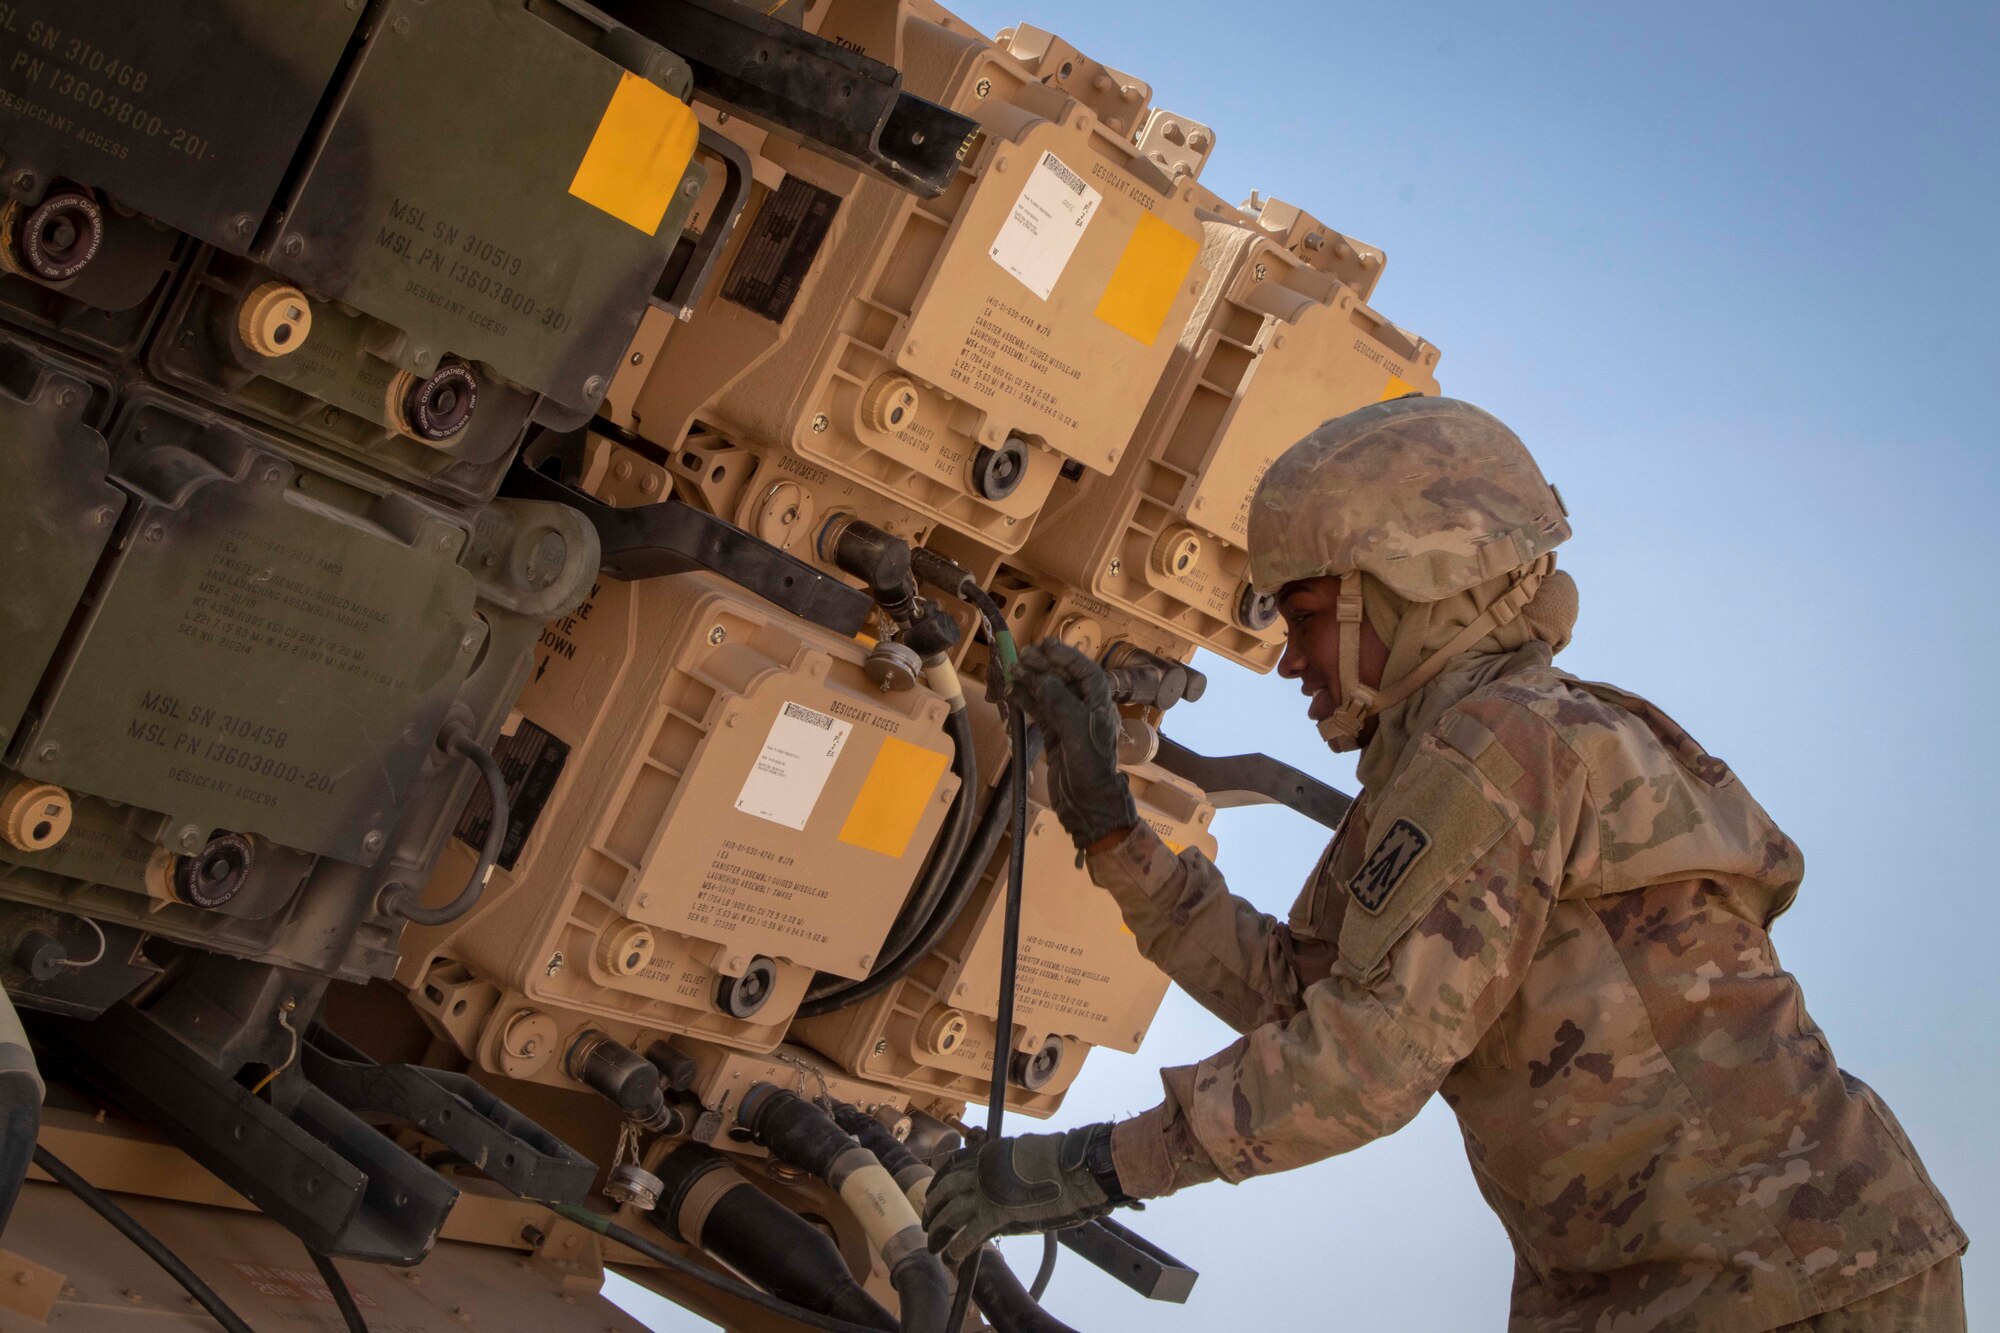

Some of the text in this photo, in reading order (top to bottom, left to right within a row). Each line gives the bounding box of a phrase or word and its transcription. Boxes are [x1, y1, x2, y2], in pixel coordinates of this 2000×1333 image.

[0, 3, 148, 92] SL SN 310468
[11, 51, 207, 158] PN 13603800-201
[0, 89, 128, 159] DESICCANT ACCESS
[1092, 162, 1154, 210] DESICCANT ACCESS
[52, 198, 78, 210] TUCSON
[65, 218, 101, 276] BREATHER VALVE
[390, 199, 521, 275] MSL SN 310519
[376, 225, 572, 333] MSL PN 13603800-301
[406, 281, 506, 336] DESICCANT ACCESS
[971, 326, 1000, 348] LAUNCHING
[976, 316, 1048, 362] CANISTER GUIDED
[434, 368, 476, 390] BREATHER VALVE
[950, 368, 961, 380] SER
[1383, 358, 1403, 378] ACCESS
[420, 406, 429, 429] TUCSON
[939, 445, 960, 463] RELIEF
[777, 454, 827, 487] DOCUMENTS
[934, 458, 954, 475] VALVE
[225, 542, 237, 553] EA
[205, 567, 281, 602] AND LAUNCHING
[1211, 586, 1229, 600] RELIEF
[316, 590, 348, 609] GUIDED
[177, 622, 251, 655] SER 210214
[538, 627, 576, 659] DOWN
[141, 691, 287, 748] MSL SN 310458
[830, 700, 899, 733] DESICCANT ACCESS
[128, 719, 335, 793] MSL PN 13603800-201
[168, 768, 277, 807] DESICCANT ACCESS
[721, 851, 728, 859] EA
[707, 871, 739, 885] LAUNCHING
[712, 860, 792, 889] CANISTER GUIDED
[687, 912, 699, 921] SER
[649, 956, 673, 969] MIDITY
[637, 967, 669, 982] DICATOR
[681, 972, 705, 985] RELIEF
[677, 984, 698, 996] VALVE
[766, 1067, 774, 1075] J2
